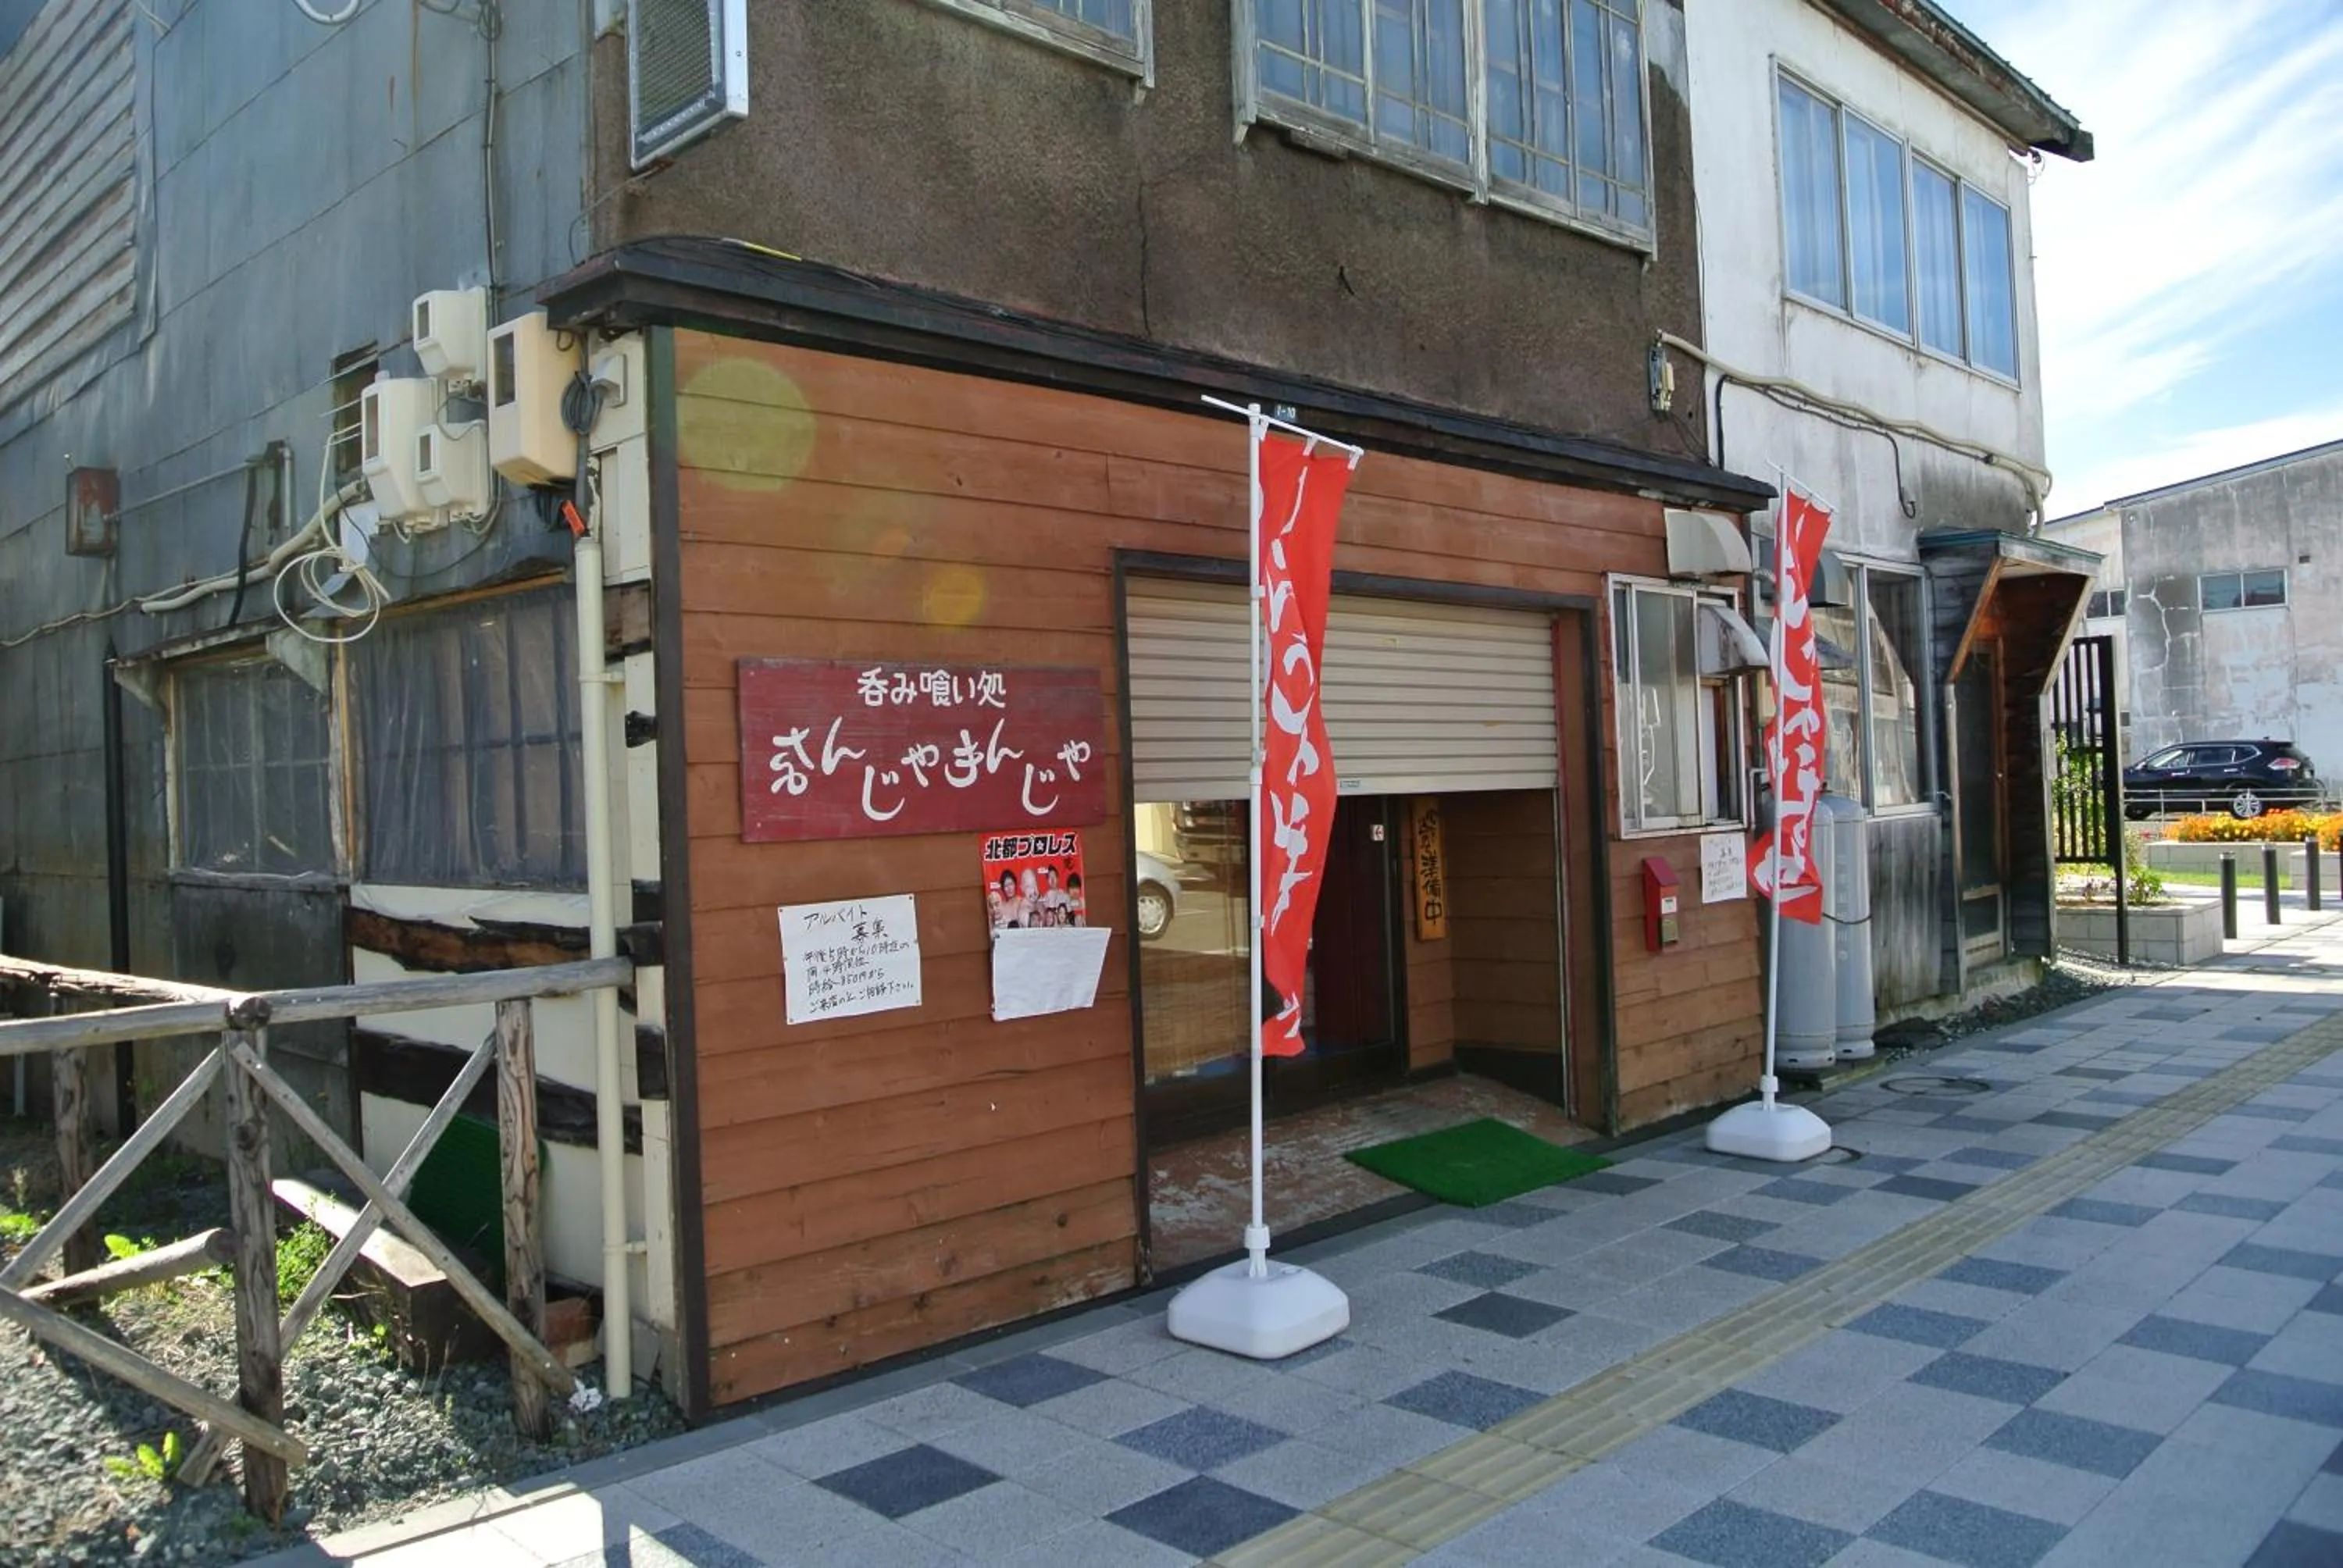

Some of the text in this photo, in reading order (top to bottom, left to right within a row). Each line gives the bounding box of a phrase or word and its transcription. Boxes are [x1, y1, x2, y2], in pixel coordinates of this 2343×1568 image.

[858, 667, 1007, 707] 呑み喰い処
[985, 832, 1077, 861] 北都プロレス
[804, 904, 868, 930] アルバイト
[851, 918, 889, 943] 募集
